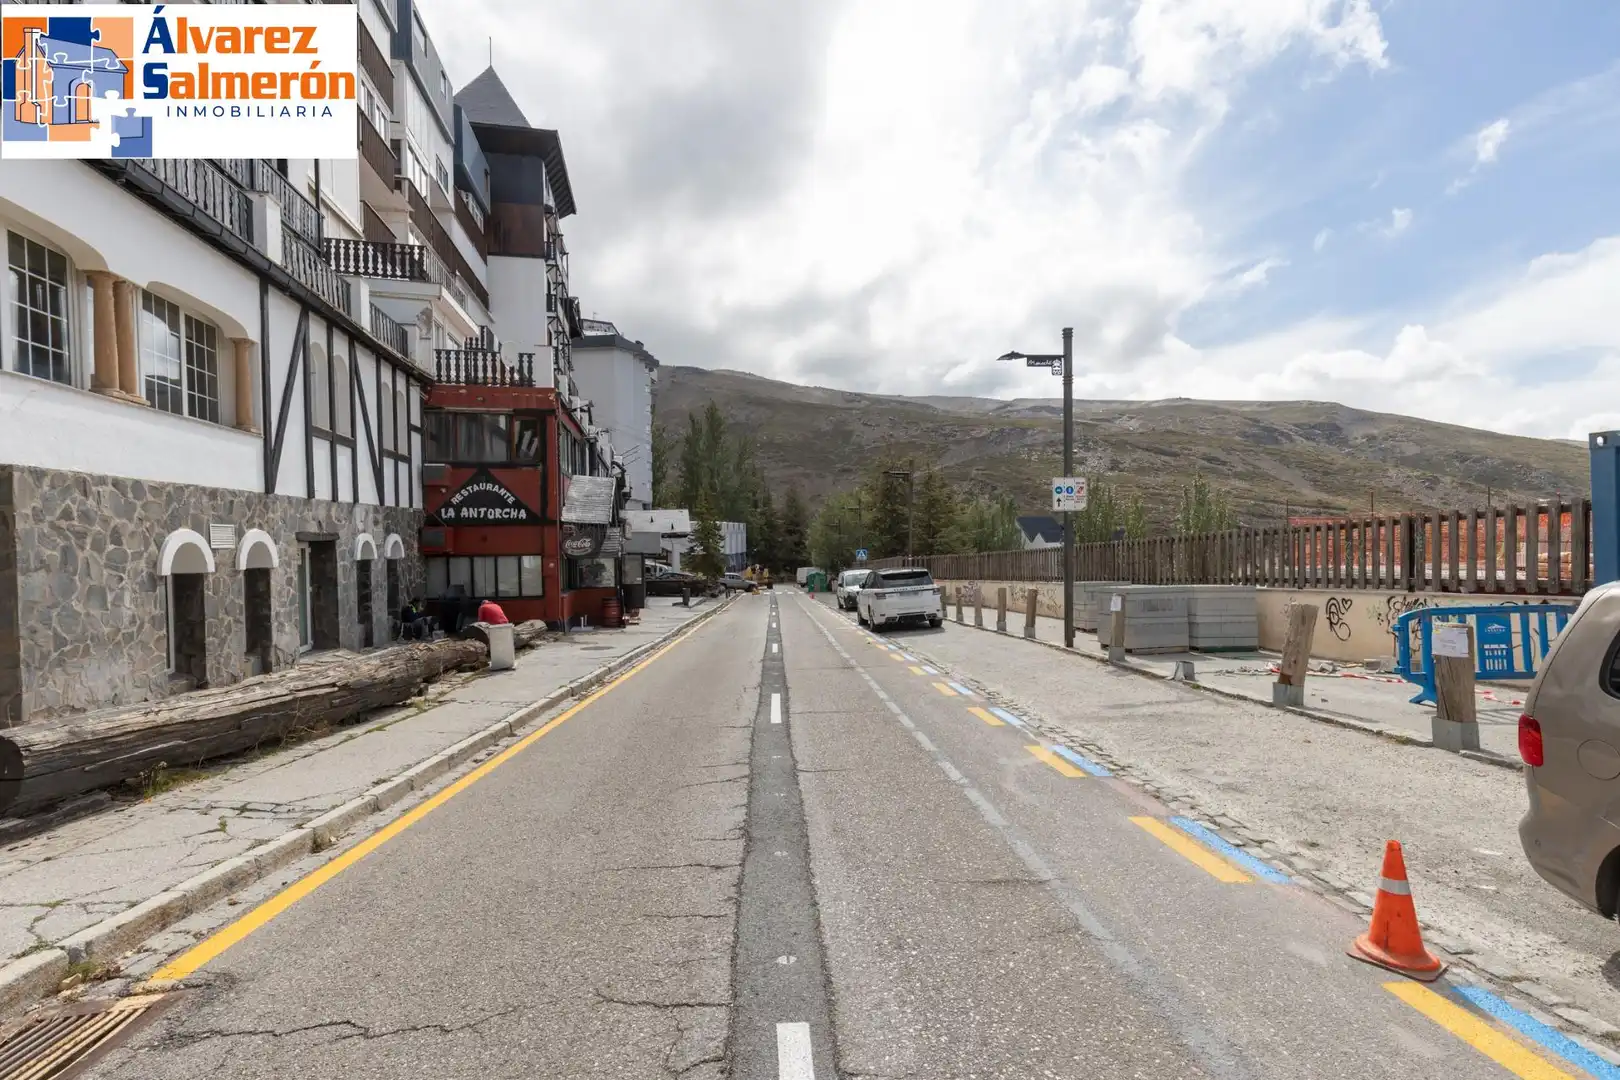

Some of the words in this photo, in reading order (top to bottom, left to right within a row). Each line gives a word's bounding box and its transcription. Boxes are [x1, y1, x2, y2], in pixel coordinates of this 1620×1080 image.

[450, 482, 516, 505] RESTAURANTE
[441, 507, 455, 519] LA
[460, 507, 527, 520] ANTORCHA
